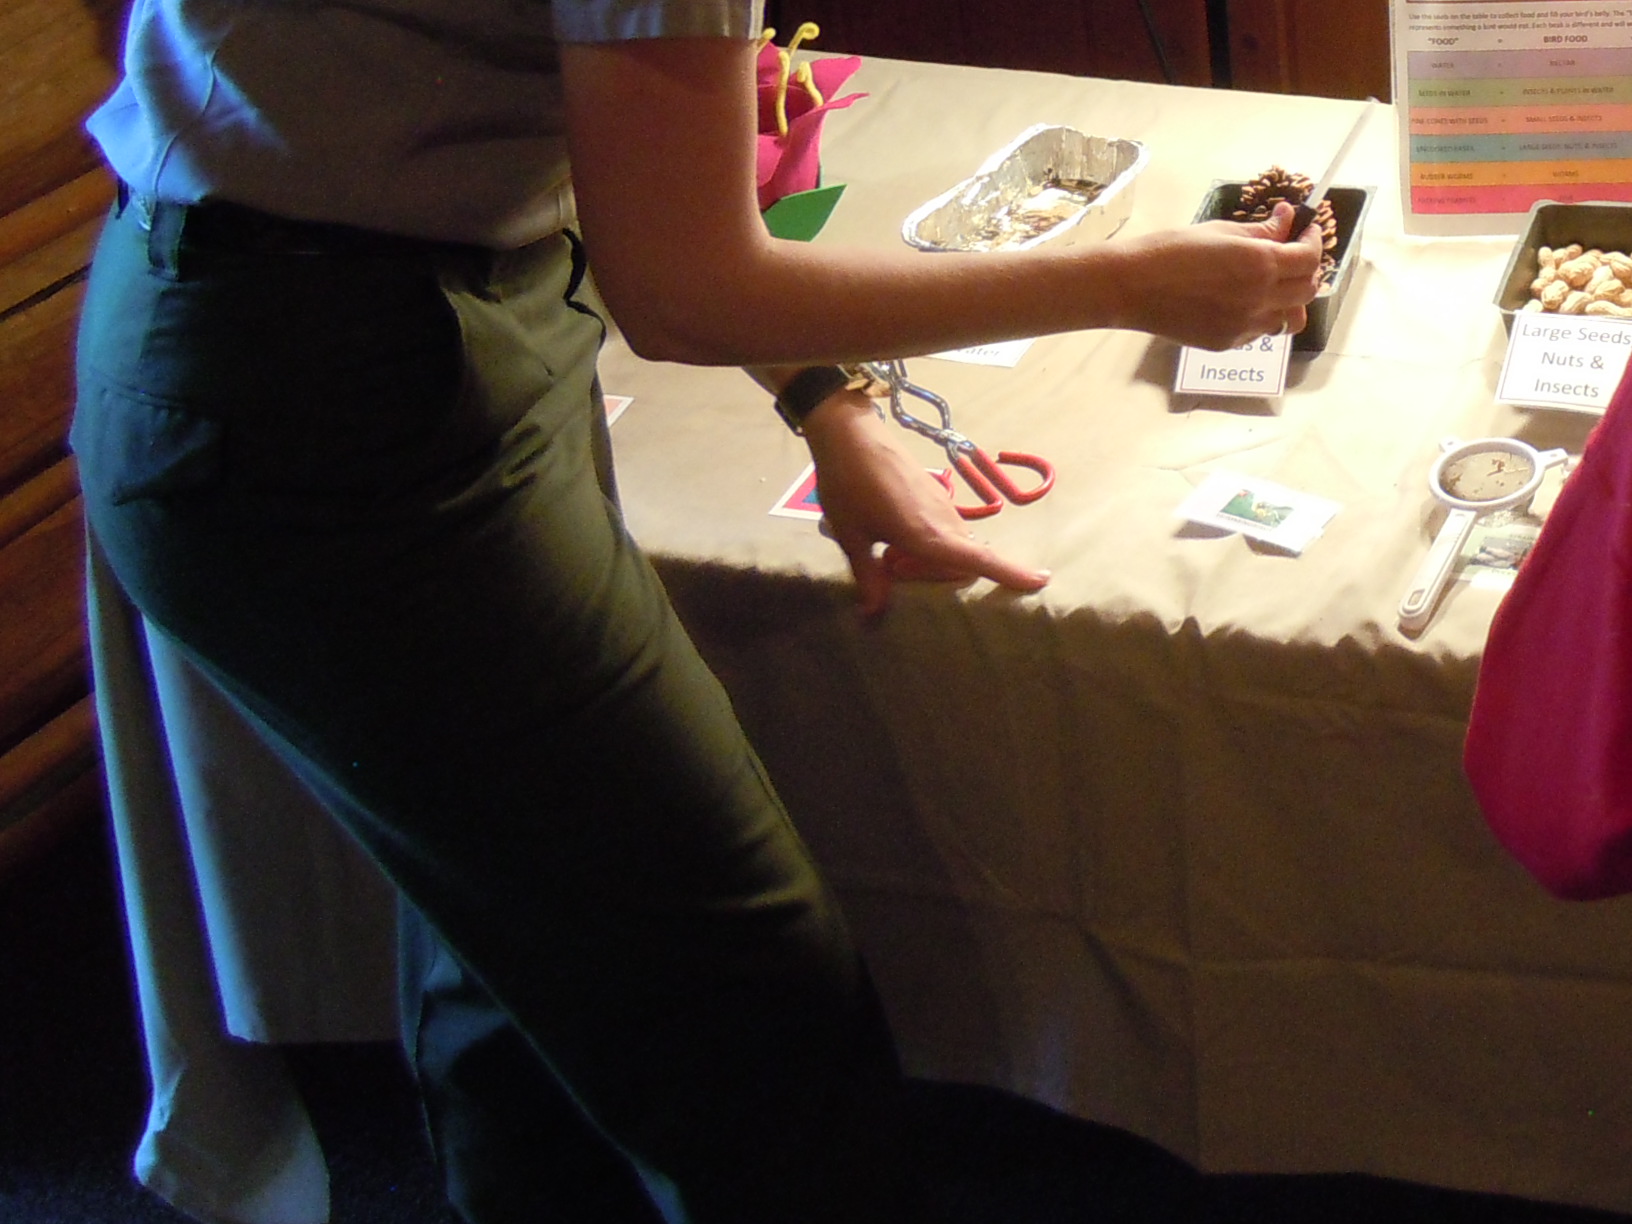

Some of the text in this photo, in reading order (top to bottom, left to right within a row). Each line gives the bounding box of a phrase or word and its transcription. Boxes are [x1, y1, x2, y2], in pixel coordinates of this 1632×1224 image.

[1543, 35, 1564, 43] BIRD
[1564, 35, 1588, 43] FOOD
[1522, 323, 1573, 342] Large
[1259, 336, 1274, 353] &
[1541, 351, 1605, 371] Nuts &
[1200, 363, 1265, 383] Insects
[1534, 377, 1600, 399] Insects
